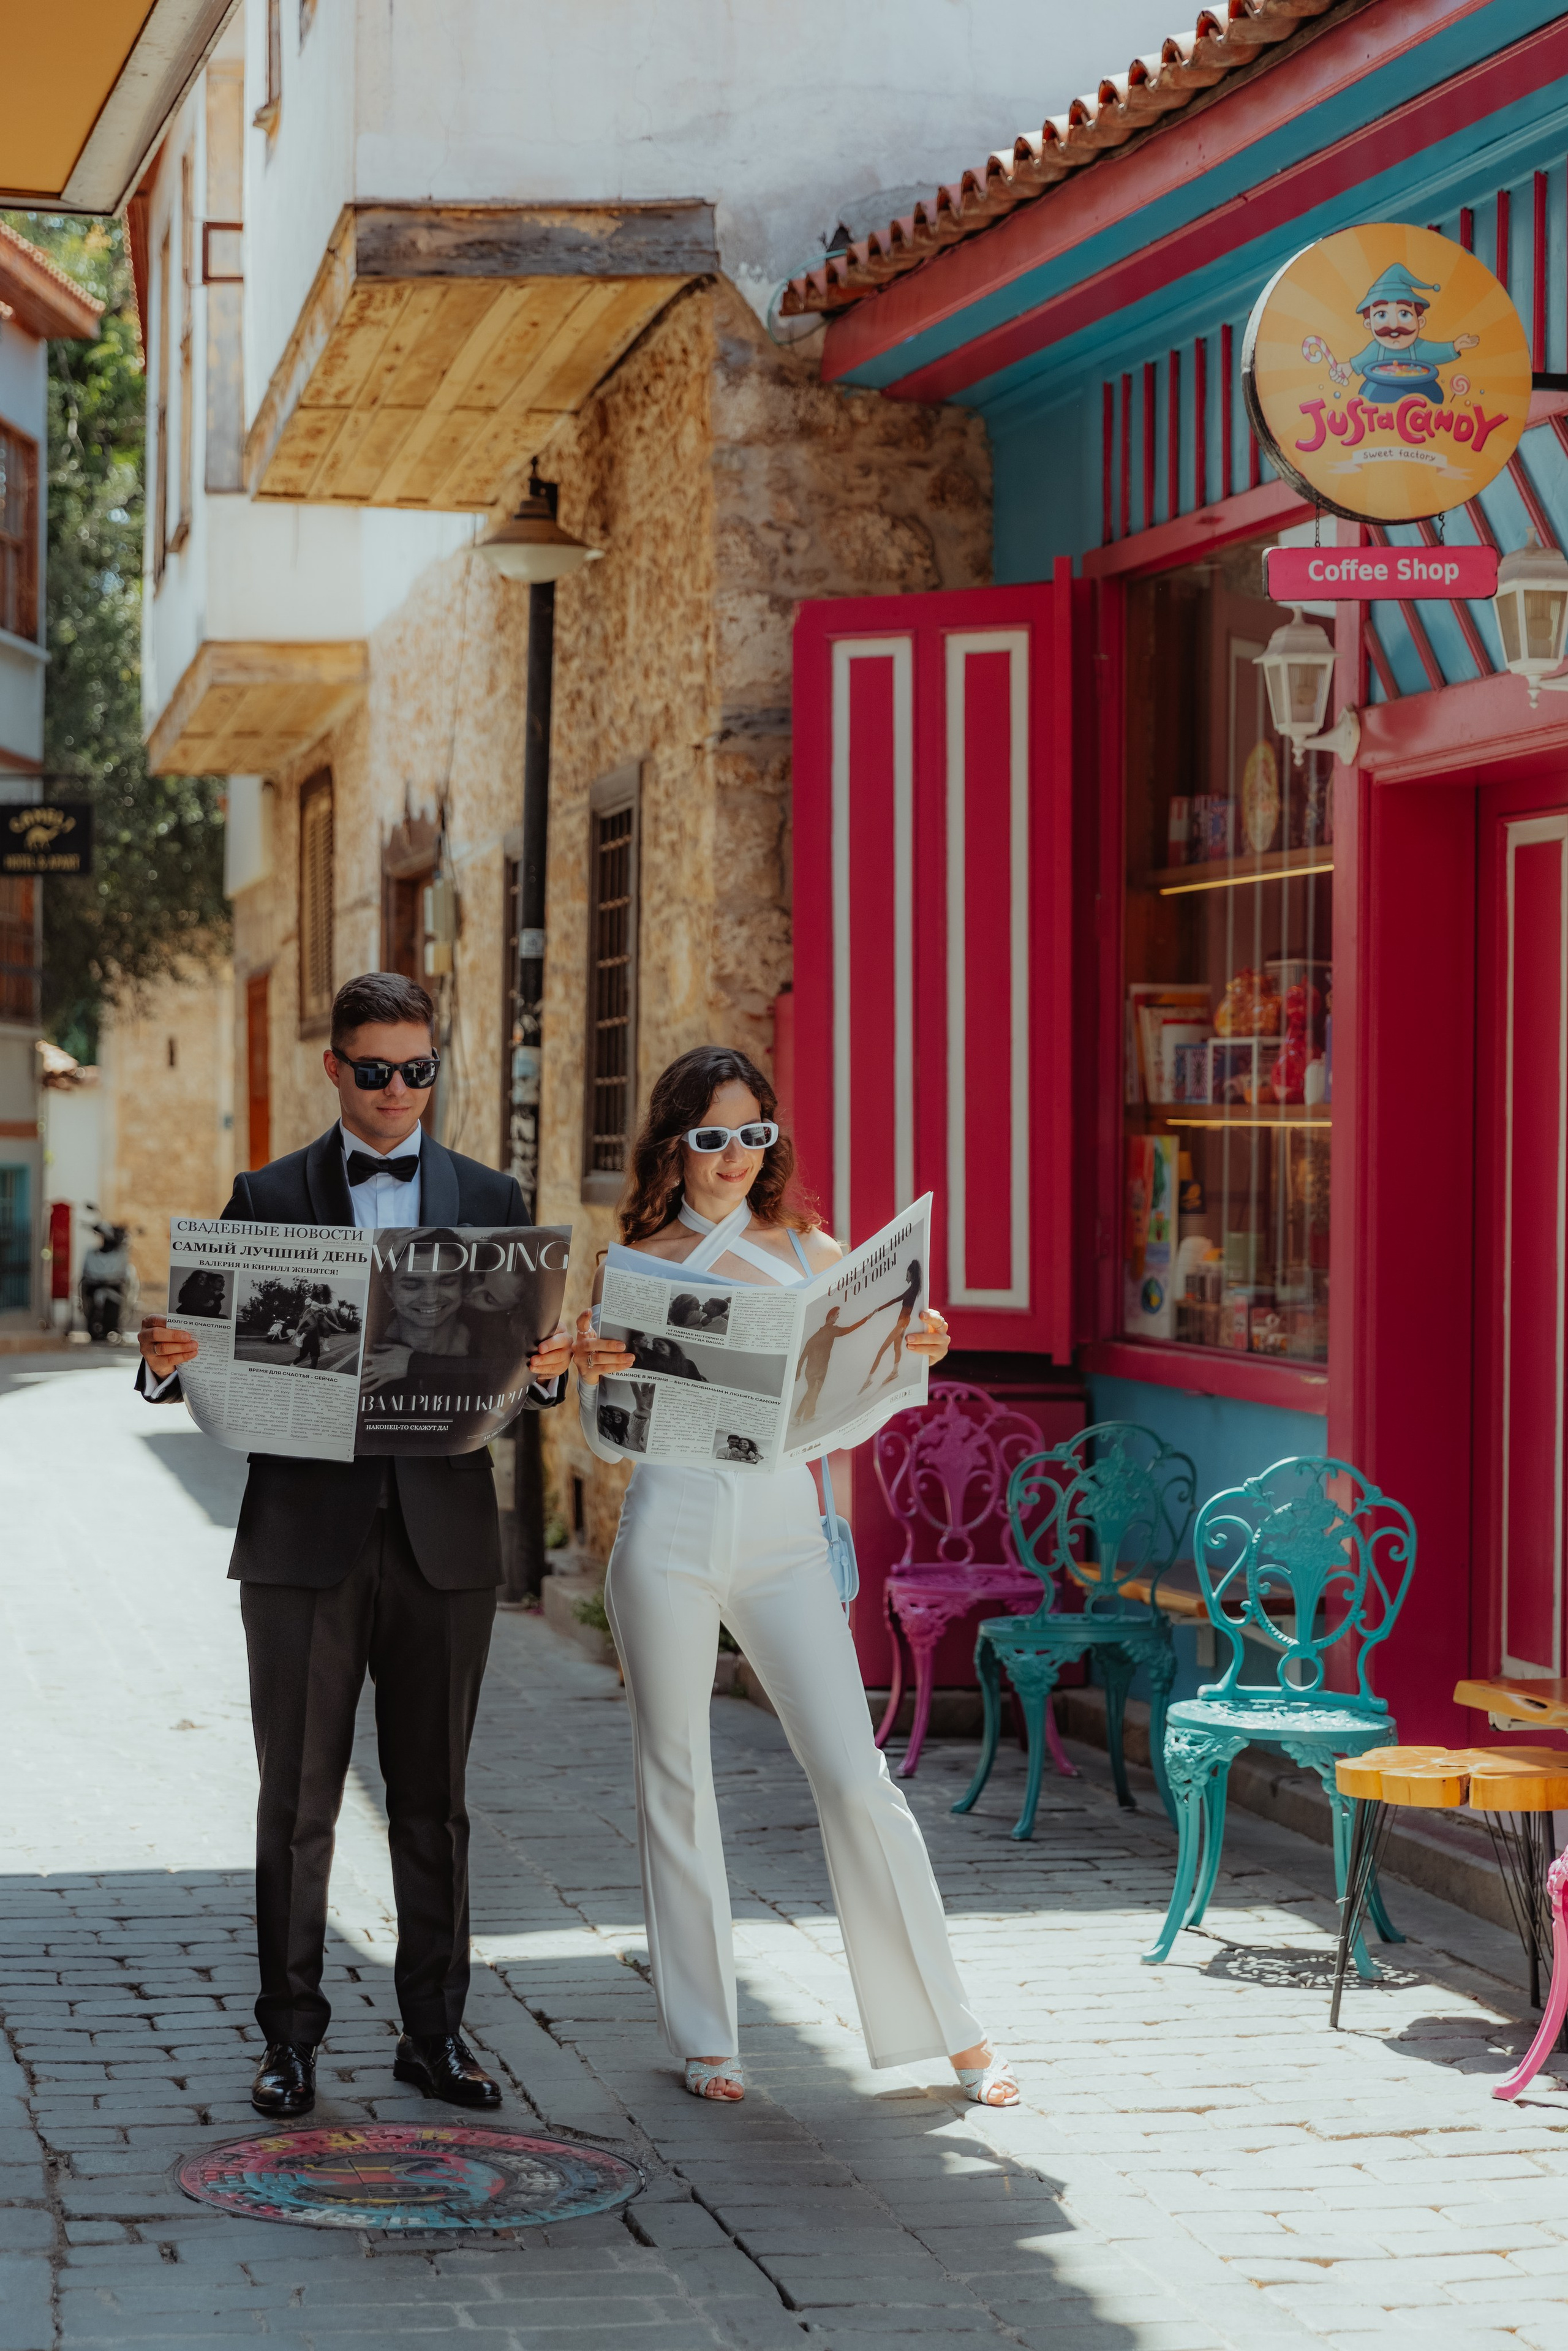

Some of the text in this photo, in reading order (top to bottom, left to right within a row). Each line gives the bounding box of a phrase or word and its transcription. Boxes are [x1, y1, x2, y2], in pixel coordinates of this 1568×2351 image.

[1363, 449, 1436, 462] sweet factory
[1308, 557, 1460, 585] Coffee Shop
[177, 1220, 364, 1241] СВАДЕБНЫЕ НОВОСТИ
[172, 1241, 368, 1263] САМЫЙ ЛУЧШИЙ ДЕНЬ
[372, 1240, 571, 1273] WEDDING
[827, 1223, 912, 1297] СОВЕРШЕННО
[199, 1259, 240, 1268] ВАЛЕРИЯ
[252, 1263, 290, 1272] КИРИЛЛ
[292, 1266, 339, 1275] ЖЕНЯТСЯ!
[844, 1252, 896, 1303] ГОТОВЫ
[691, 1384, 723, 1394] ЛЮБИМЫМ
[889, 1389, 913, 1403] BRIDE
[361, 1395, 450, 1411] ВАЛЕРИЯ
[457, 1395, 470, 1411] И
